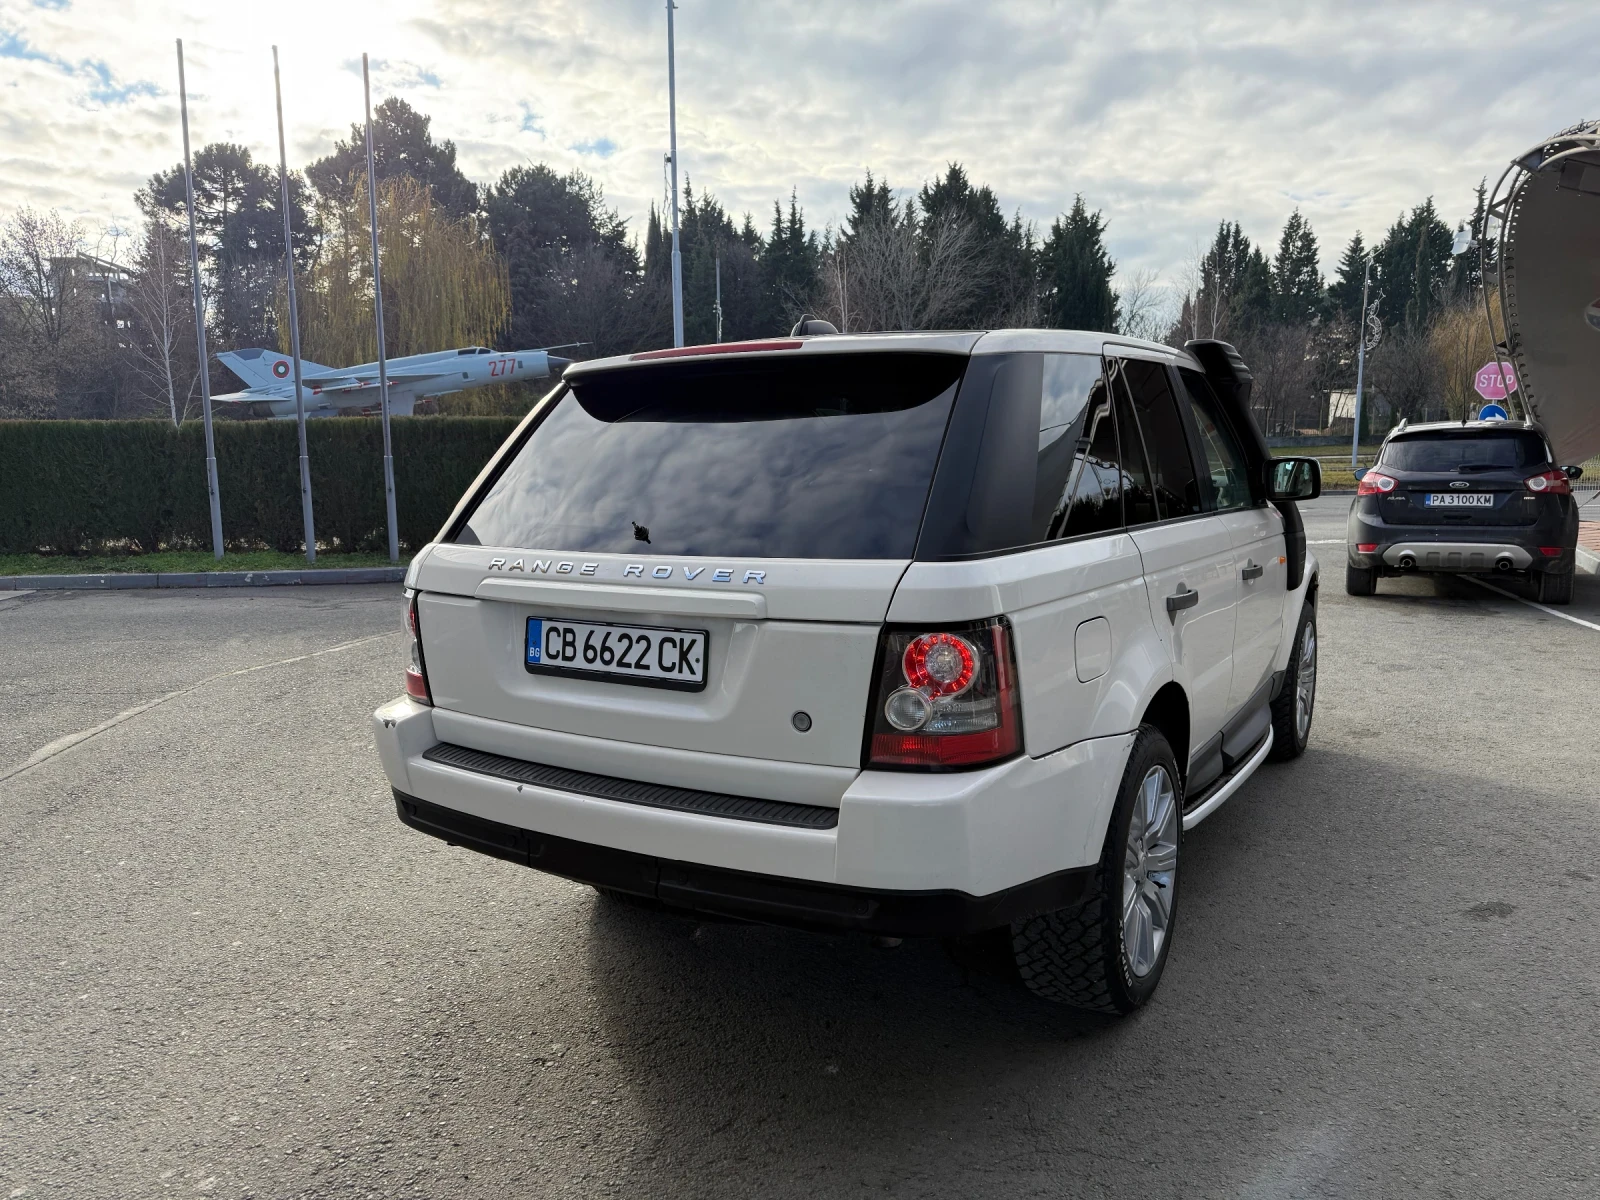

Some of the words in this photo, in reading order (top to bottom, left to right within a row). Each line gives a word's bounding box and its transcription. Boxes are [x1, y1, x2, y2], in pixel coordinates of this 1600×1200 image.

[488, 358, 516, 378] 277
[1480, 374, 1514, 388] STOP
[1432, 494, 1446, 505] PA
[1448, 494, 1474, 505] 3100
[1476, 494, 1492, 505] KM
[488, 557, 599, 576] RANGE
[623, 564, 767, 584] ROVER
[529, 647, 540, 658] BG
[545, 626, 577, 662] CB
[583, 630, 651, 670] 6622
[657, 637, 697, 675] CK
